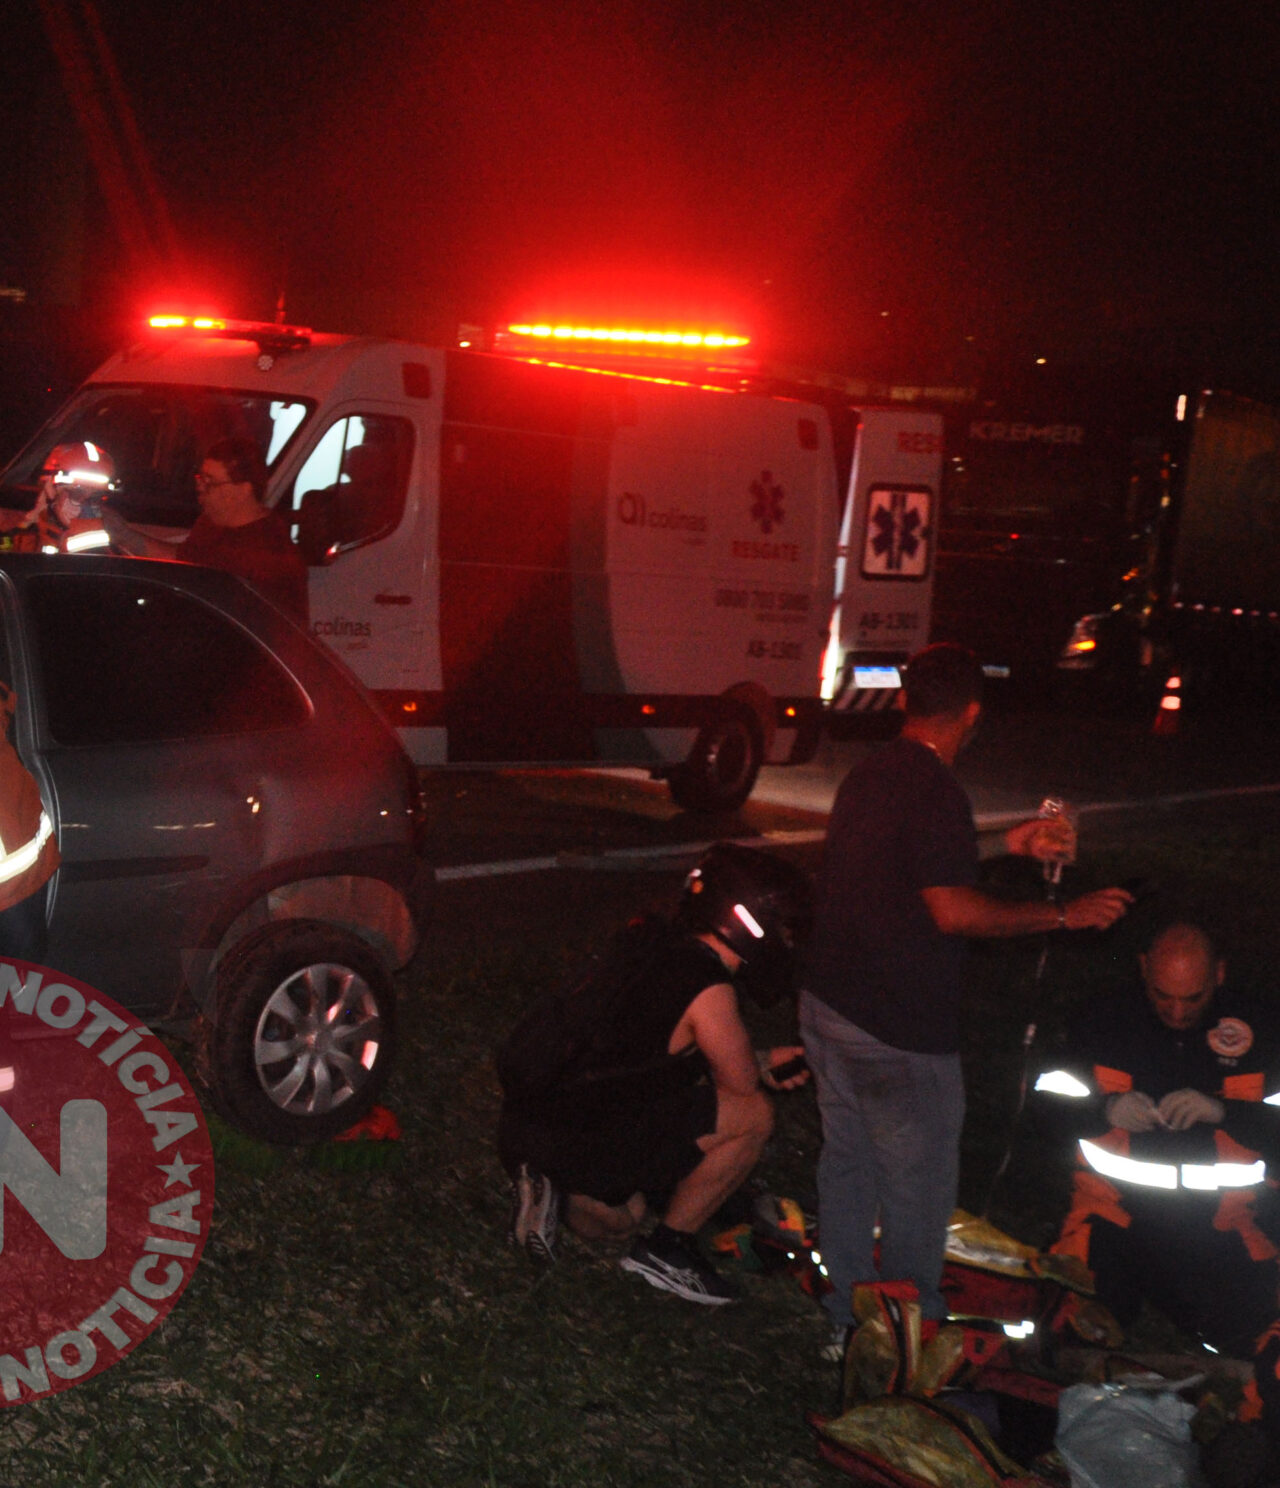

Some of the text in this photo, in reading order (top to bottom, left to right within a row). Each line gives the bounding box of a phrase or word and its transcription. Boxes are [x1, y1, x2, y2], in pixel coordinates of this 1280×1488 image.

[968, 422, 1084, 444] KREMER
[732, 540, 800, 562] RESGATE
[313, 617, 371, 637] colinas
